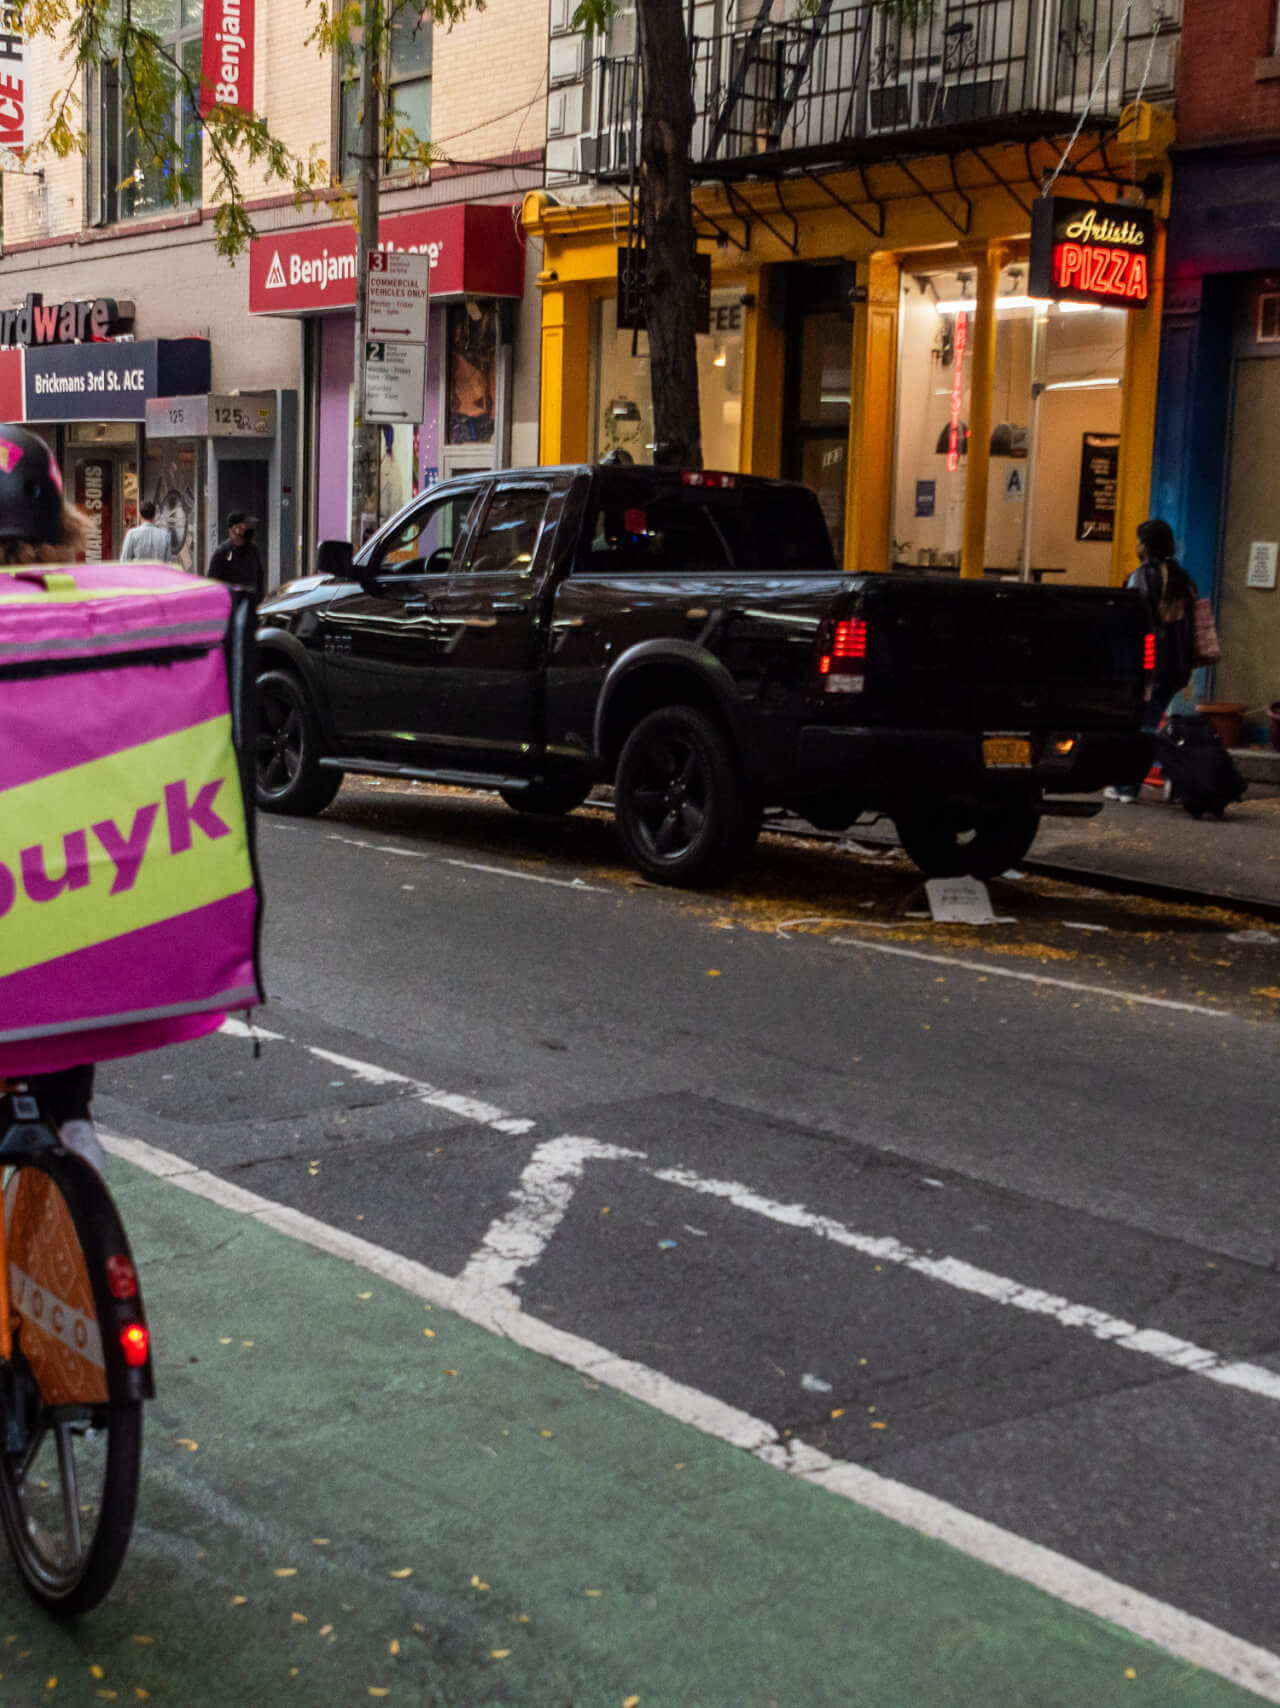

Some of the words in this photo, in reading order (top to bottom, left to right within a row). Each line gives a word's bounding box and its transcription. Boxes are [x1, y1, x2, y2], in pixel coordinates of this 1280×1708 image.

[1065, 208, 1145, 245] Artistic
[290, 249, 357, 291] Benjam
[373, 254, 383, 272] 3
[1060, 242, 1148, 300] PIZZA
[370, 279, 419, 288] COMMERCIAL
[370, 288, 405, 297] VEHICLES
[407, 289, 426, 298] ONLY
[369, 343, 380, 361] 2
[35, 373, 85, 394] Brickmans
[87, 370, 105, 391] 3rd
[107, 370, 121, 391] St.
[123, 369, 145, 391] ACE
[169, 409, 184, 424] 125
[215, 408, 242, 424] 125
[85, 465, 103, 510] SONS
[1007, 468, 1021, 492] A
[85, 527, 102, 563] MAN
